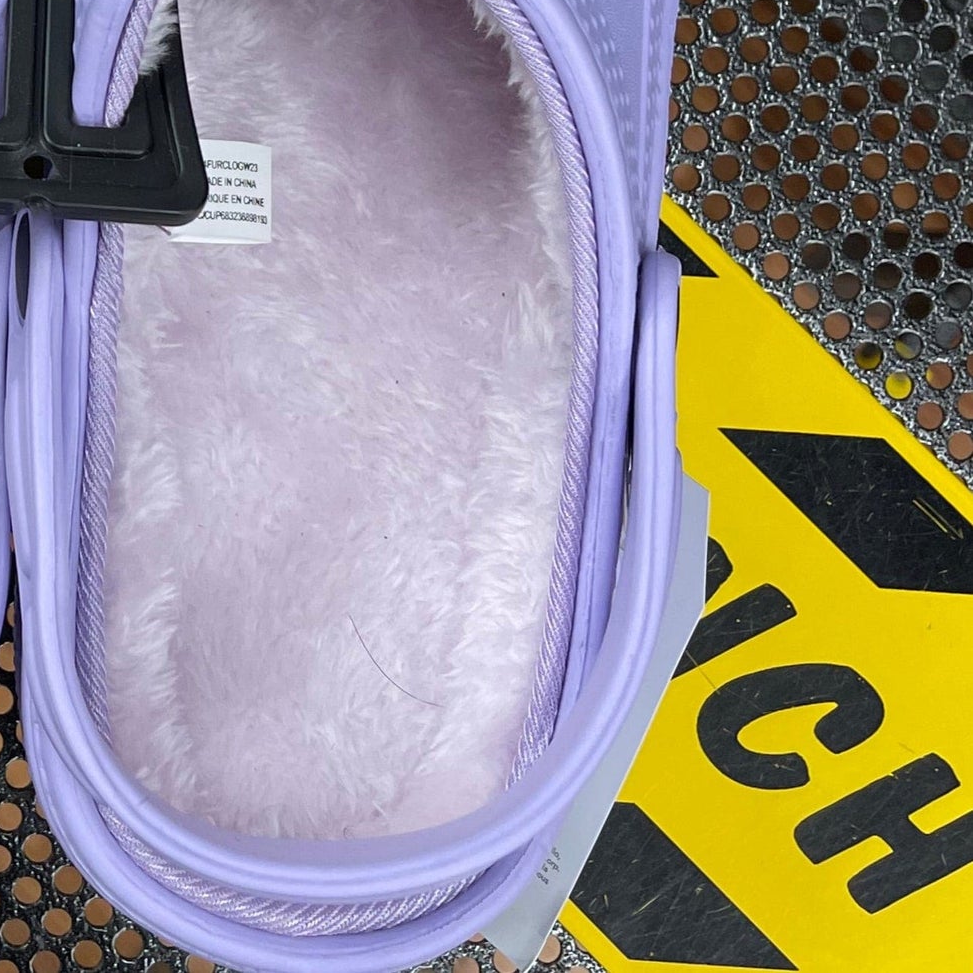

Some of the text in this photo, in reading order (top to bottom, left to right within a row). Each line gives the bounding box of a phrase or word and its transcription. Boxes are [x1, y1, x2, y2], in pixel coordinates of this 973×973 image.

[207, 177, 257, 189] ADE IN CHINA
[208, 193, 265, 208] IQUE EN CHINE
